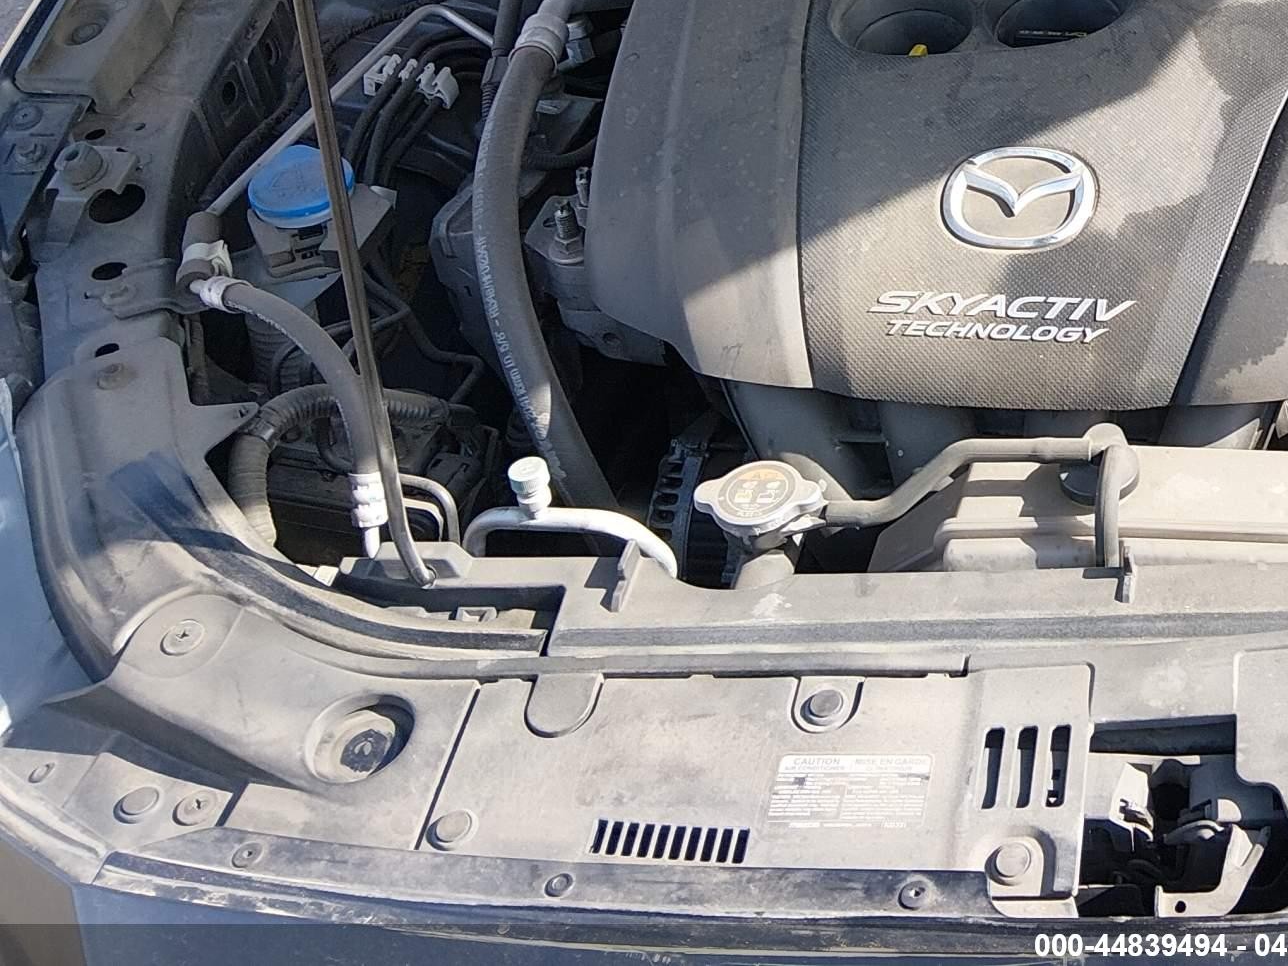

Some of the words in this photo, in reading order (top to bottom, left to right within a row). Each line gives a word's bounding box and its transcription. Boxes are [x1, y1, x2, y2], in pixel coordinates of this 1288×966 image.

[867, 290, 1137, 322] SKYACTIV
[886, 319, 1110, 344] TECHNOLOGY
[793, 757, 841, 766] CAUTION
